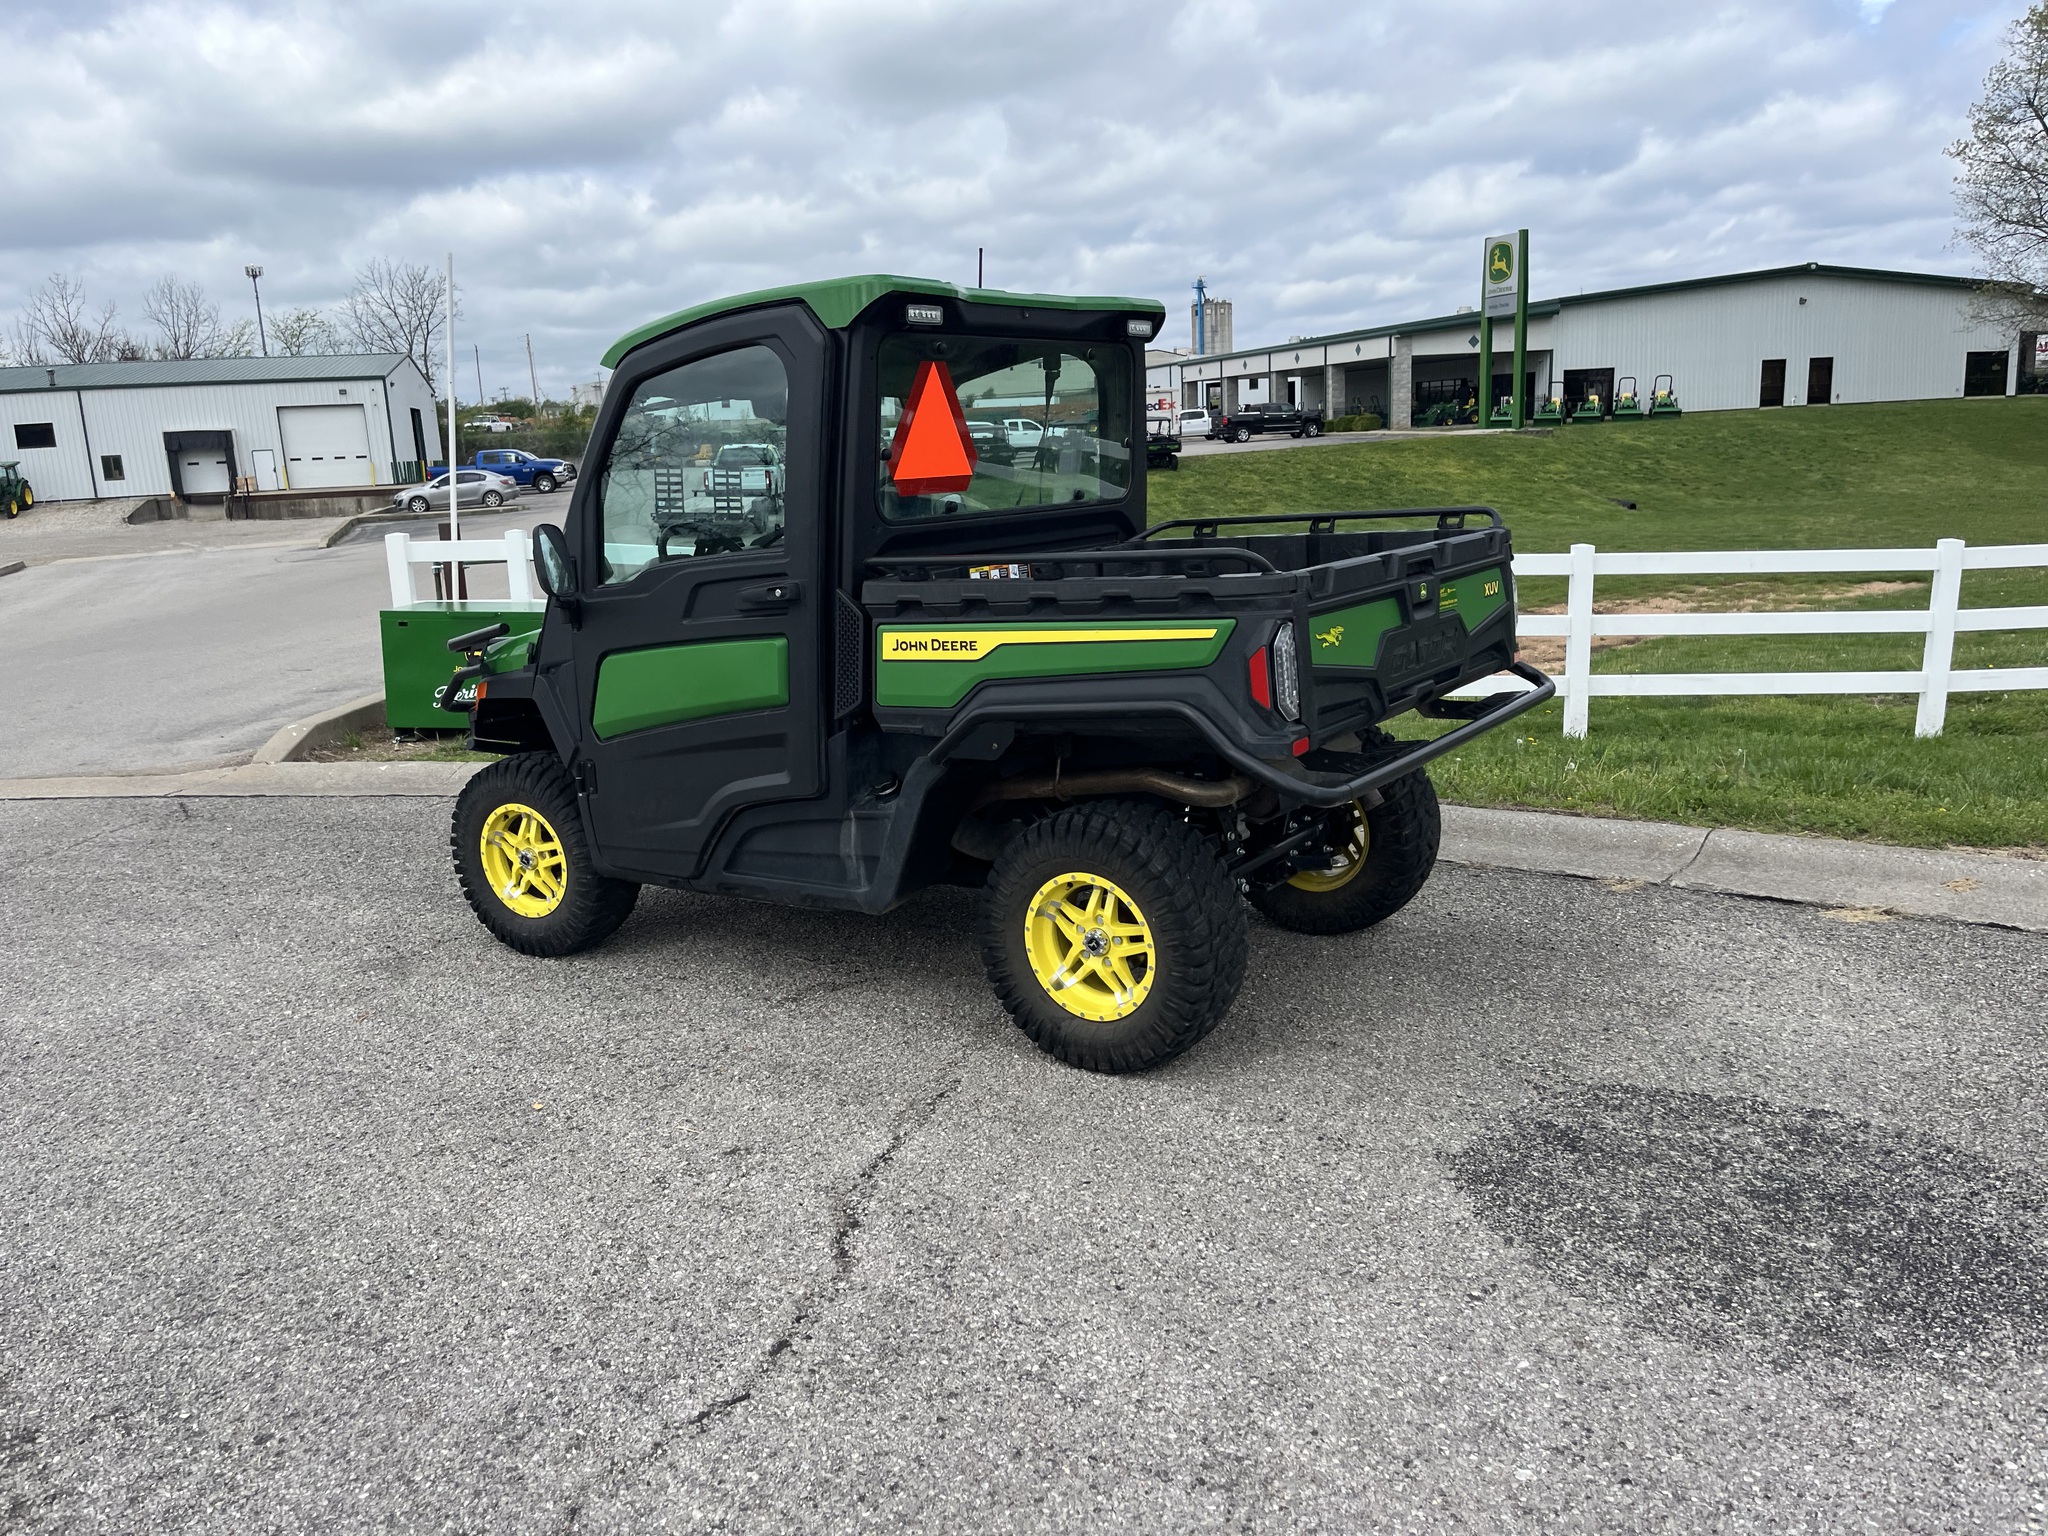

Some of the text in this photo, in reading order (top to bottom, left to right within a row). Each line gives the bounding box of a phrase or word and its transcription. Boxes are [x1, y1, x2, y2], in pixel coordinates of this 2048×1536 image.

[1146, 398, 1176, 412] edEx
[1484, 580, 1499, 597] XUV
[892, 638, 978, 652] JOHN DEERE
